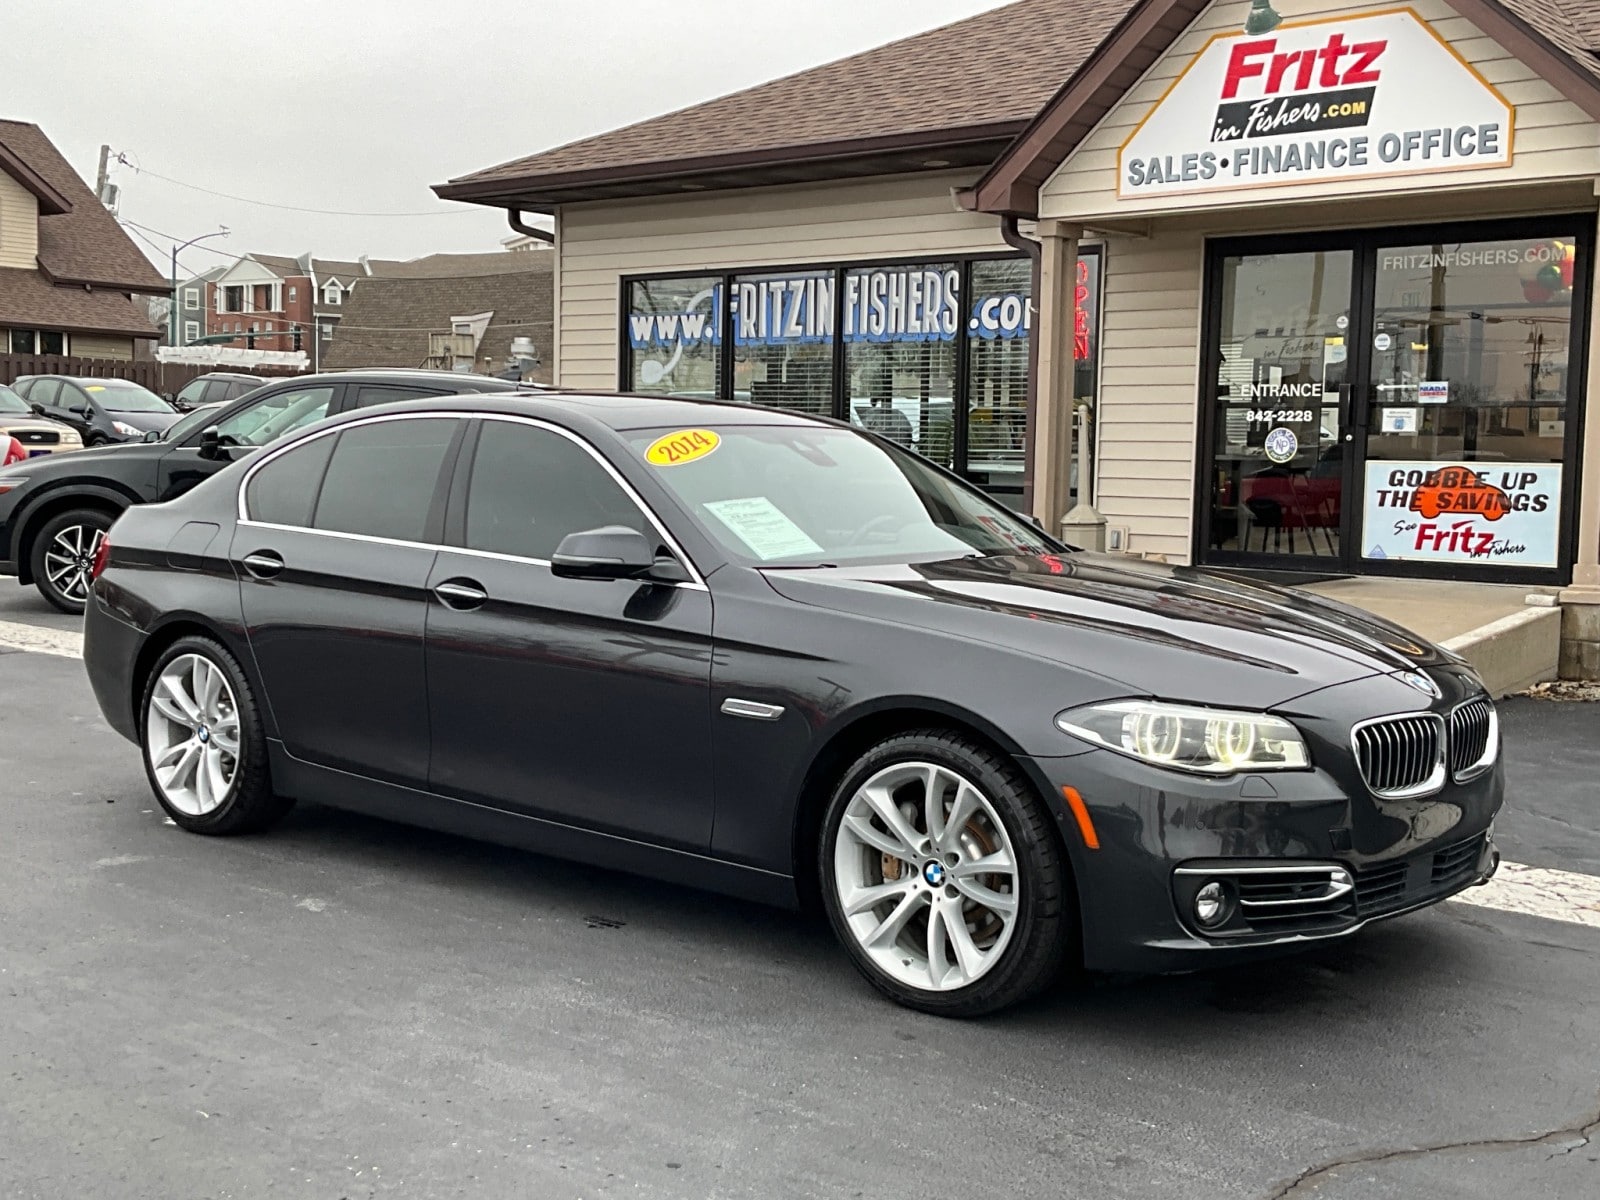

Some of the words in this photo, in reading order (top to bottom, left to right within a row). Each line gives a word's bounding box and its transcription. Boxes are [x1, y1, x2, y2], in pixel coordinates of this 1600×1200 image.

[1220, 33, 1388, 99] Fritz
[1213, 118, 1241, 142] in
[1377, 123, 1500, 163] OFFICE
[1382, 247, 1567, 271] FRITZINFISHERS.COM
[1241, 383, 1322, 397] ENTRANCE
[1246, 410, 1313, 422] 842-2228
[658, 431, 712, 463] 2014
[1388, 469, 1490, 489] GOBBLE
[1501, 472, 1538, 490] UP
[1376, 490, 1426, 509] THE
[1436, 491, 1550, 512] SAVINGS
[1393, 519, 1418, 535] See
[1414, 520, 1496, 555] Fritz
[1486, 538, 1527, 560] Fishers
